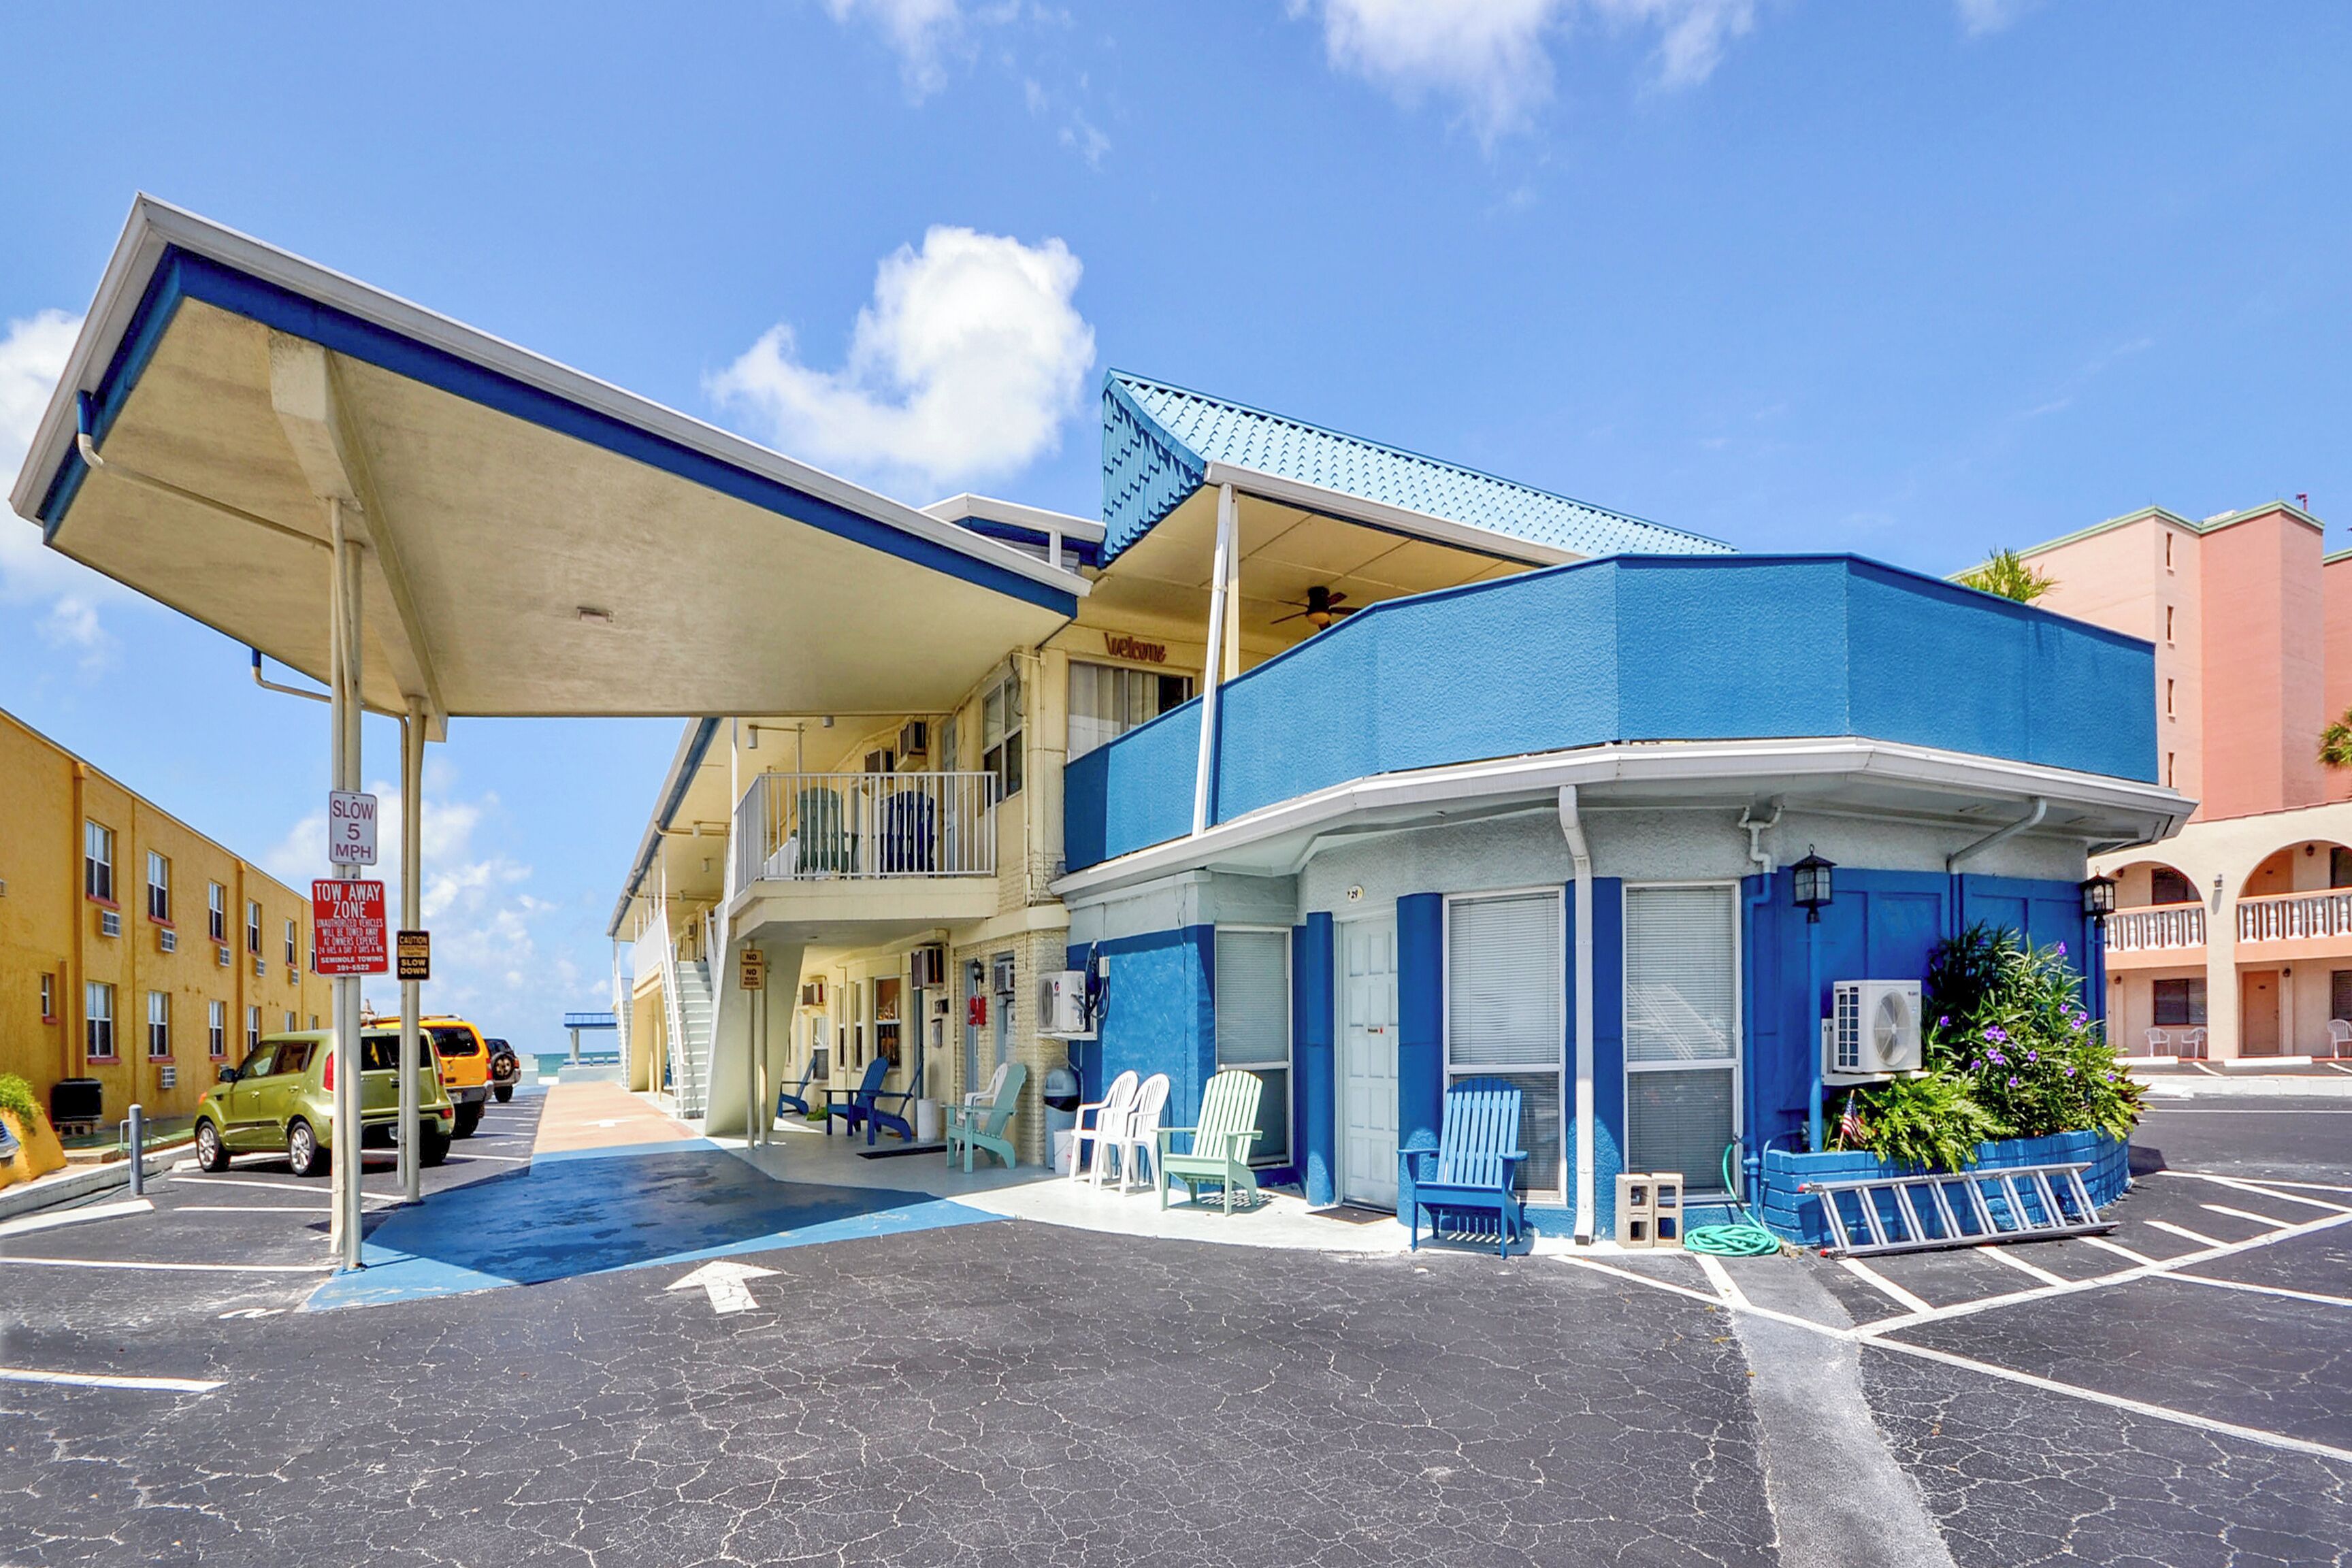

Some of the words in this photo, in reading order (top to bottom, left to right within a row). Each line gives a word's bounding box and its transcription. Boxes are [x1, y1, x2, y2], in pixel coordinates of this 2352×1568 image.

[332, 800, 374, 819] SLOW
[347, 823, 361, 840] 5
[336, 843, 371, 859] MPH
[314, 883, 342, 901] TOW
[348, 884, 380, 901] AWAY
[333, 900, 367, 919] ZONE
[316, 918, 357, 928] UNAUTHORIZED
[359, 918, 383, 927] VEHICLES
[323, 928, 334, 936] WILL
[337, 928, 344, 936] BE
[346, 927, 363, 936] TOWED
[365, 927, 378, 936] AWAY
[356, 936, 378, 945] EXPENSE
[399, 936, 428, 944] CAUTION
[400, 967, 427, 975] DOWN
